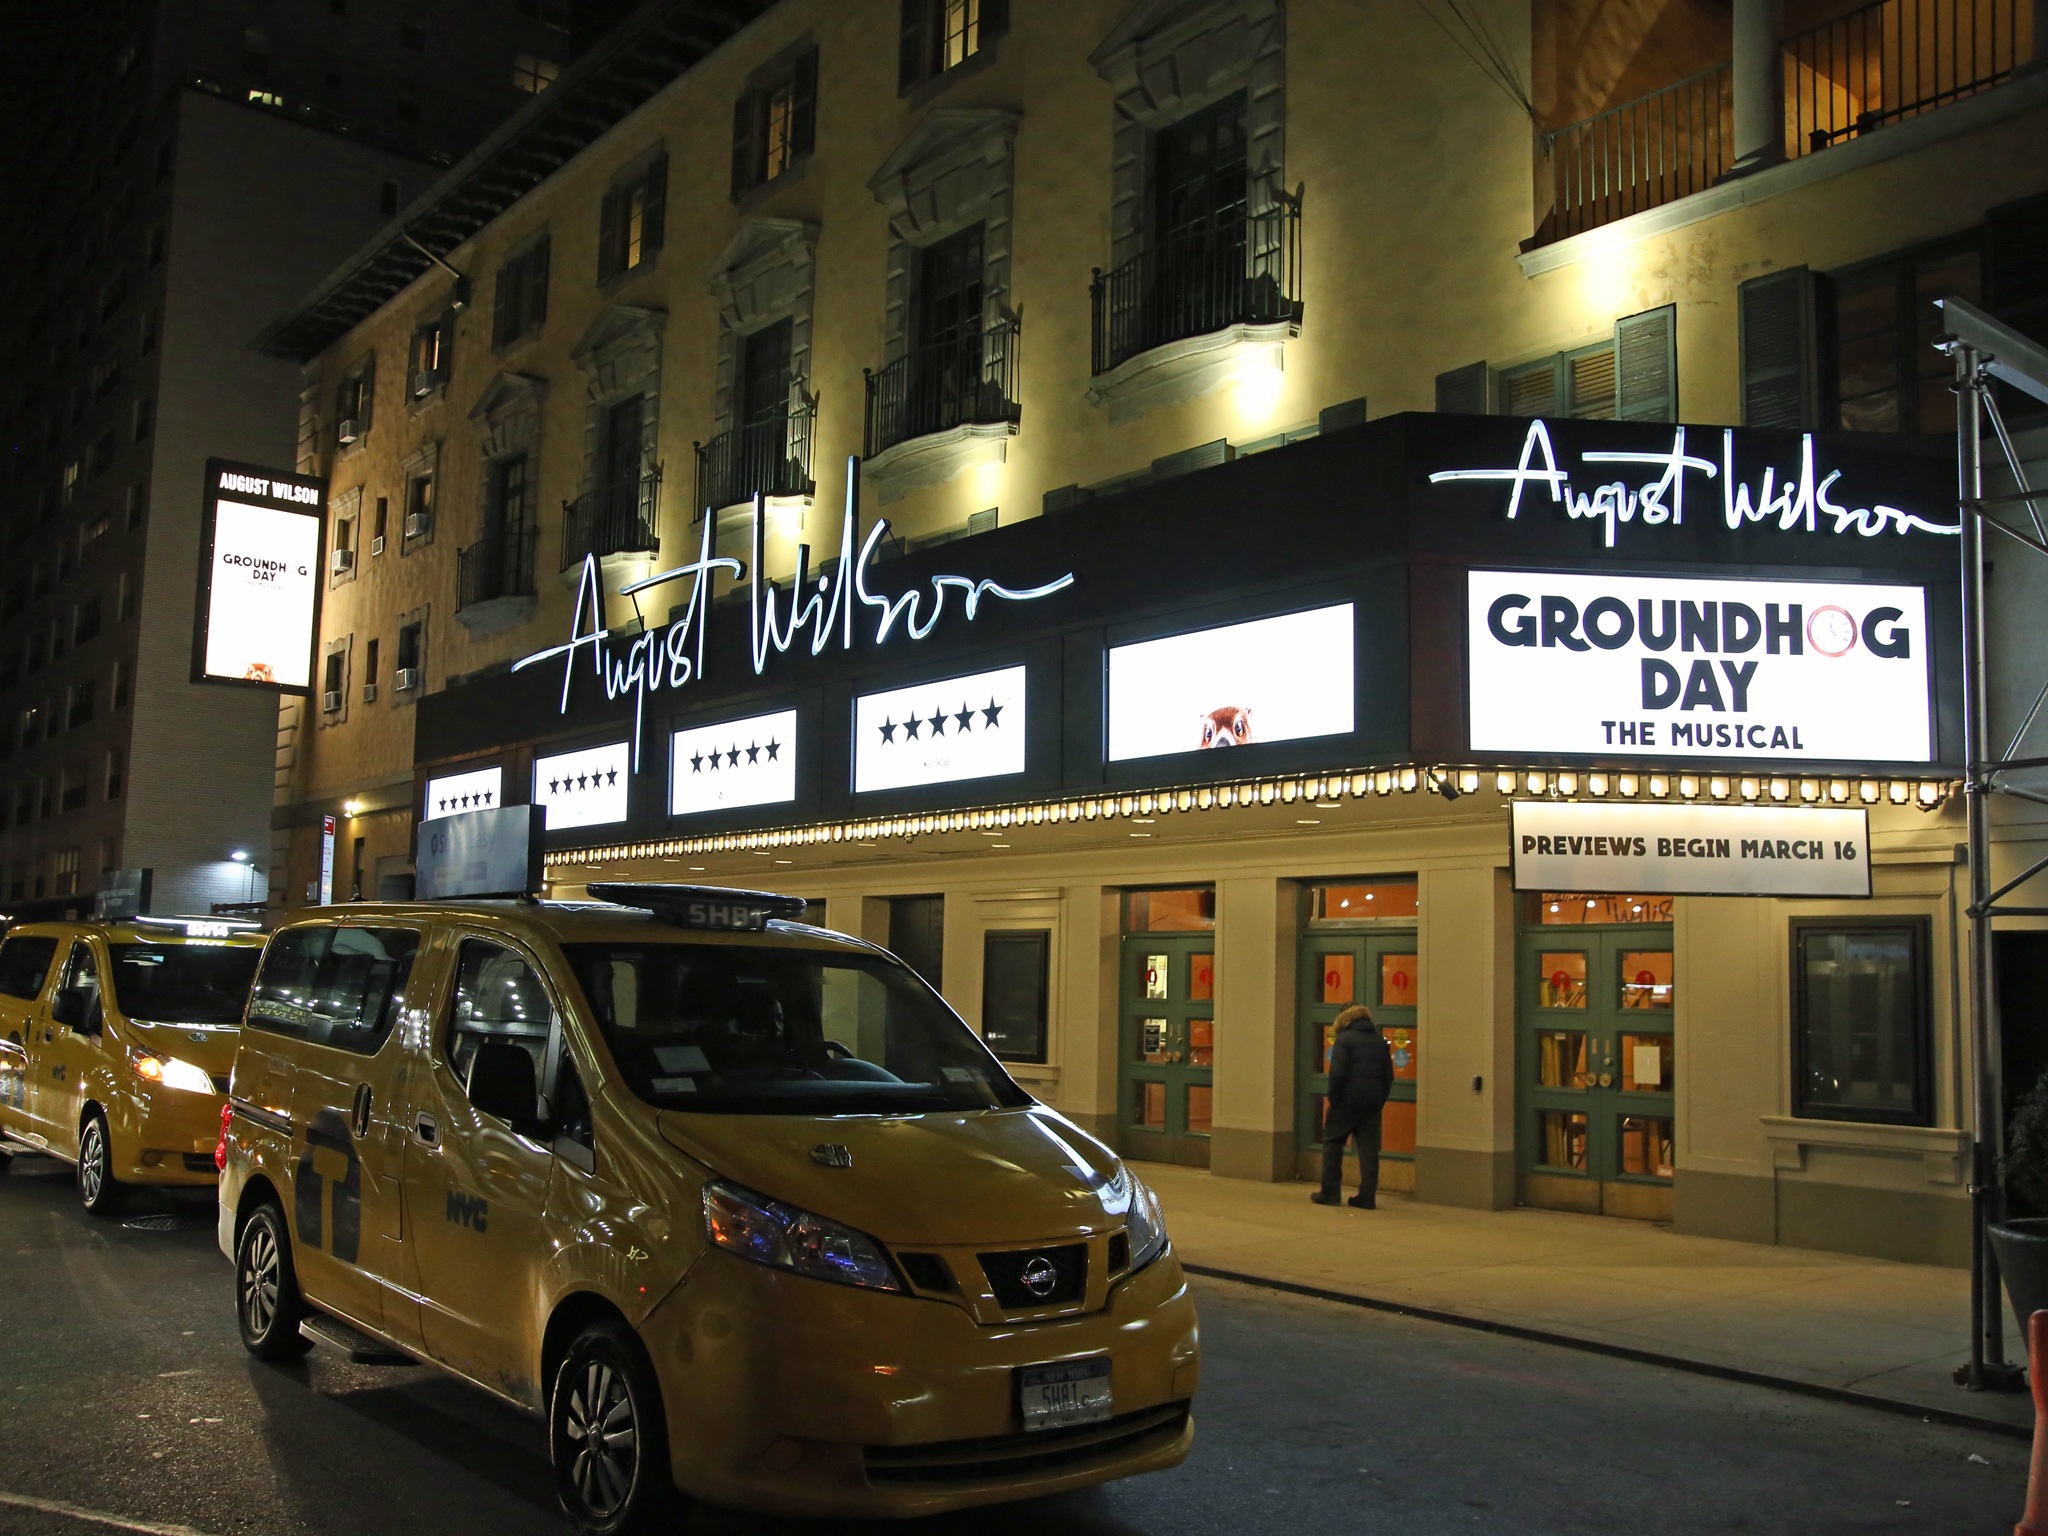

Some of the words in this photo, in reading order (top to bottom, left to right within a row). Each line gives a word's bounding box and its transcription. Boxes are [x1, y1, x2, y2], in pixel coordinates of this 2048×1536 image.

[219, 472, 270, 496] AUGUST
[271, 481, 319, 505] WILSON
[1429, 419, 1716, 547] August
[1722, 428, 1964, 537] Wilson
[223, 554, 307, 576] GROUNDHG
[253, 570, 276, 582] DAY
[511, 507, 746, 773] August
[751, 456, 1076, 675] Wilson
[1640, 657, 1759, 712] DAY
[1601, 720, 1657, 746] THE
[1670, 721, 1804, 751] MUSICAL
[1521, 834, 1647, 858] PREVIEWS
[1656, 836, 1731, 859] BEGIN
[1740, 838, 1825, 861] MARCH
[1832, 841, 1857, 861] 16
[447, 1189, 488, 1232] NYC
